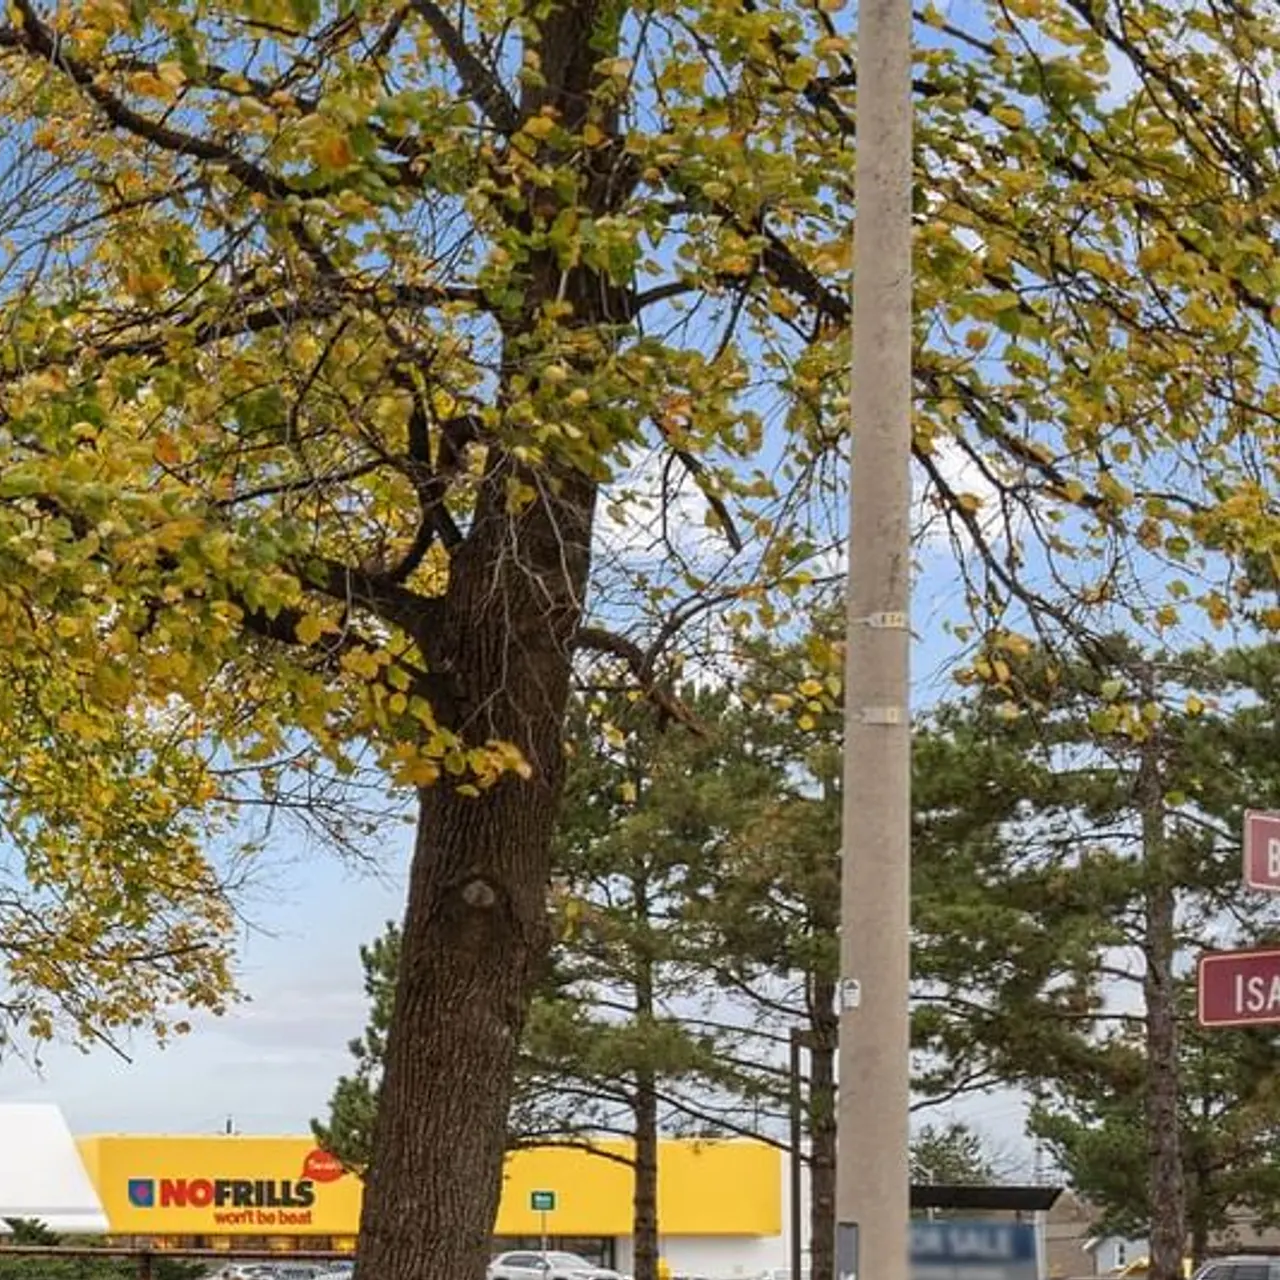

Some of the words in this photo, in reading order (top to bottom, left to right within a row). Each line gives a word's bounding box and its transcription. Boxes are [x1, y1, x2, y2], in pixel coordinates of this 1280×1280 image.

[213, 1210, 254, 1225] won't
[257, 1210, 276, 1225] be
[279, 1210, 312, 1225] beat
